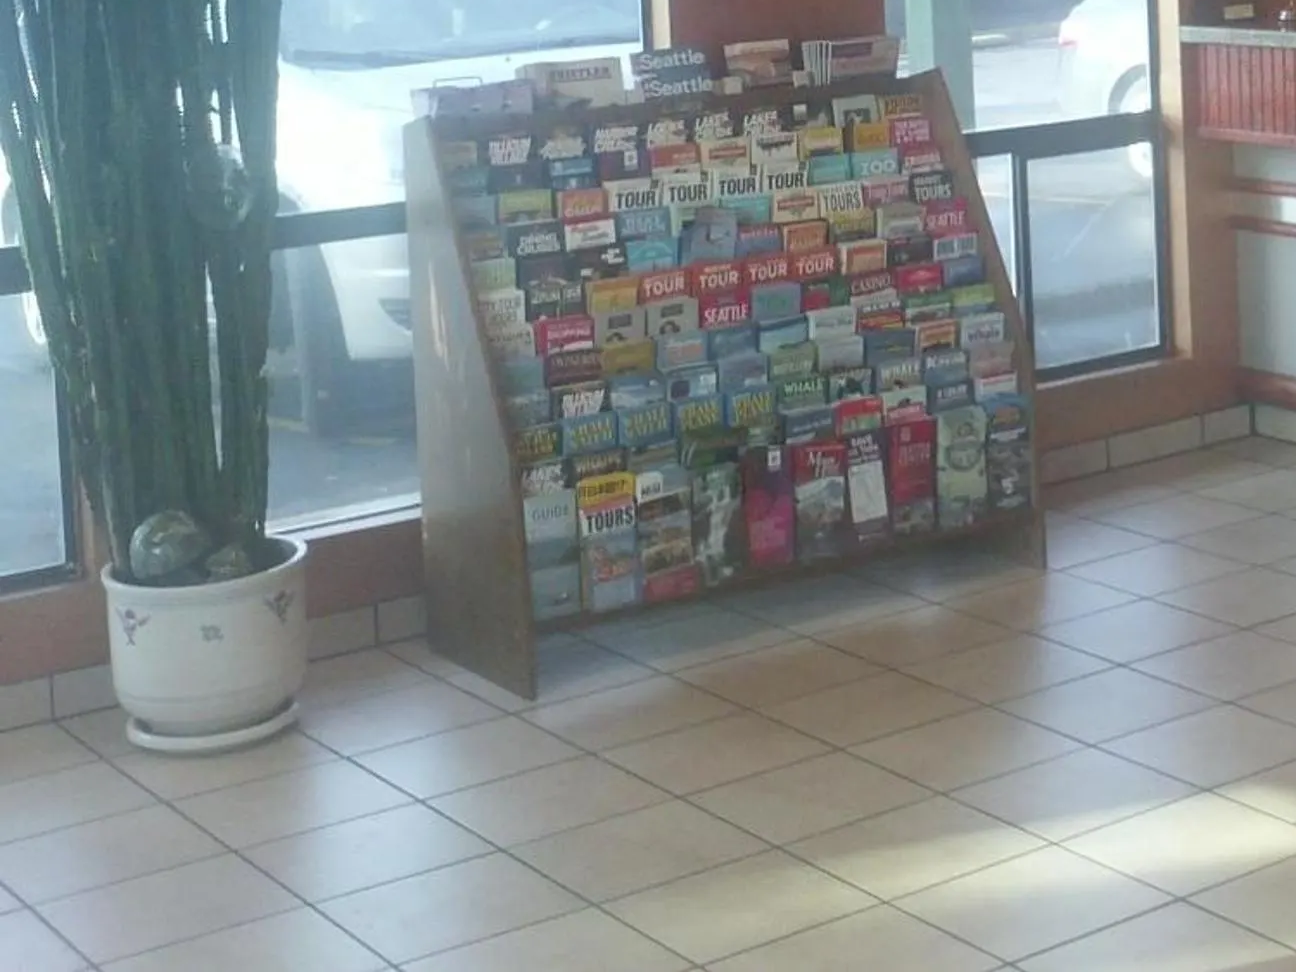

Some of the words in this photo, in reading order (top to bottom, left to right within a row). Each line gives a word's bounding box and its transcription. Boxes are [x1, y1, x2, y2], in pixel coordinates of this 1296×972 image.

[639, 48, 706, 71] Seattle
[649, 76, 714, 98] Seattle
[719, 178, 756, 196] TOUR
[767, 172, 804, 190] TOUR
[615, 191, 657, 209] TOUR
[669, 184, 708, 203] TOUR
[824, 191, 861, 211] TOURS
[914, 184, 951, 203] TOURS
[750, 262, 788, 280] TOUR
[795, 258, 836, 275] TOUR
[643, 276, 685, 298] TOUR
[700, 271, 739, 289] TOUR
[704, 303, 749, 324] SEATTLE
[586, 506, 634, 533] TOURS
